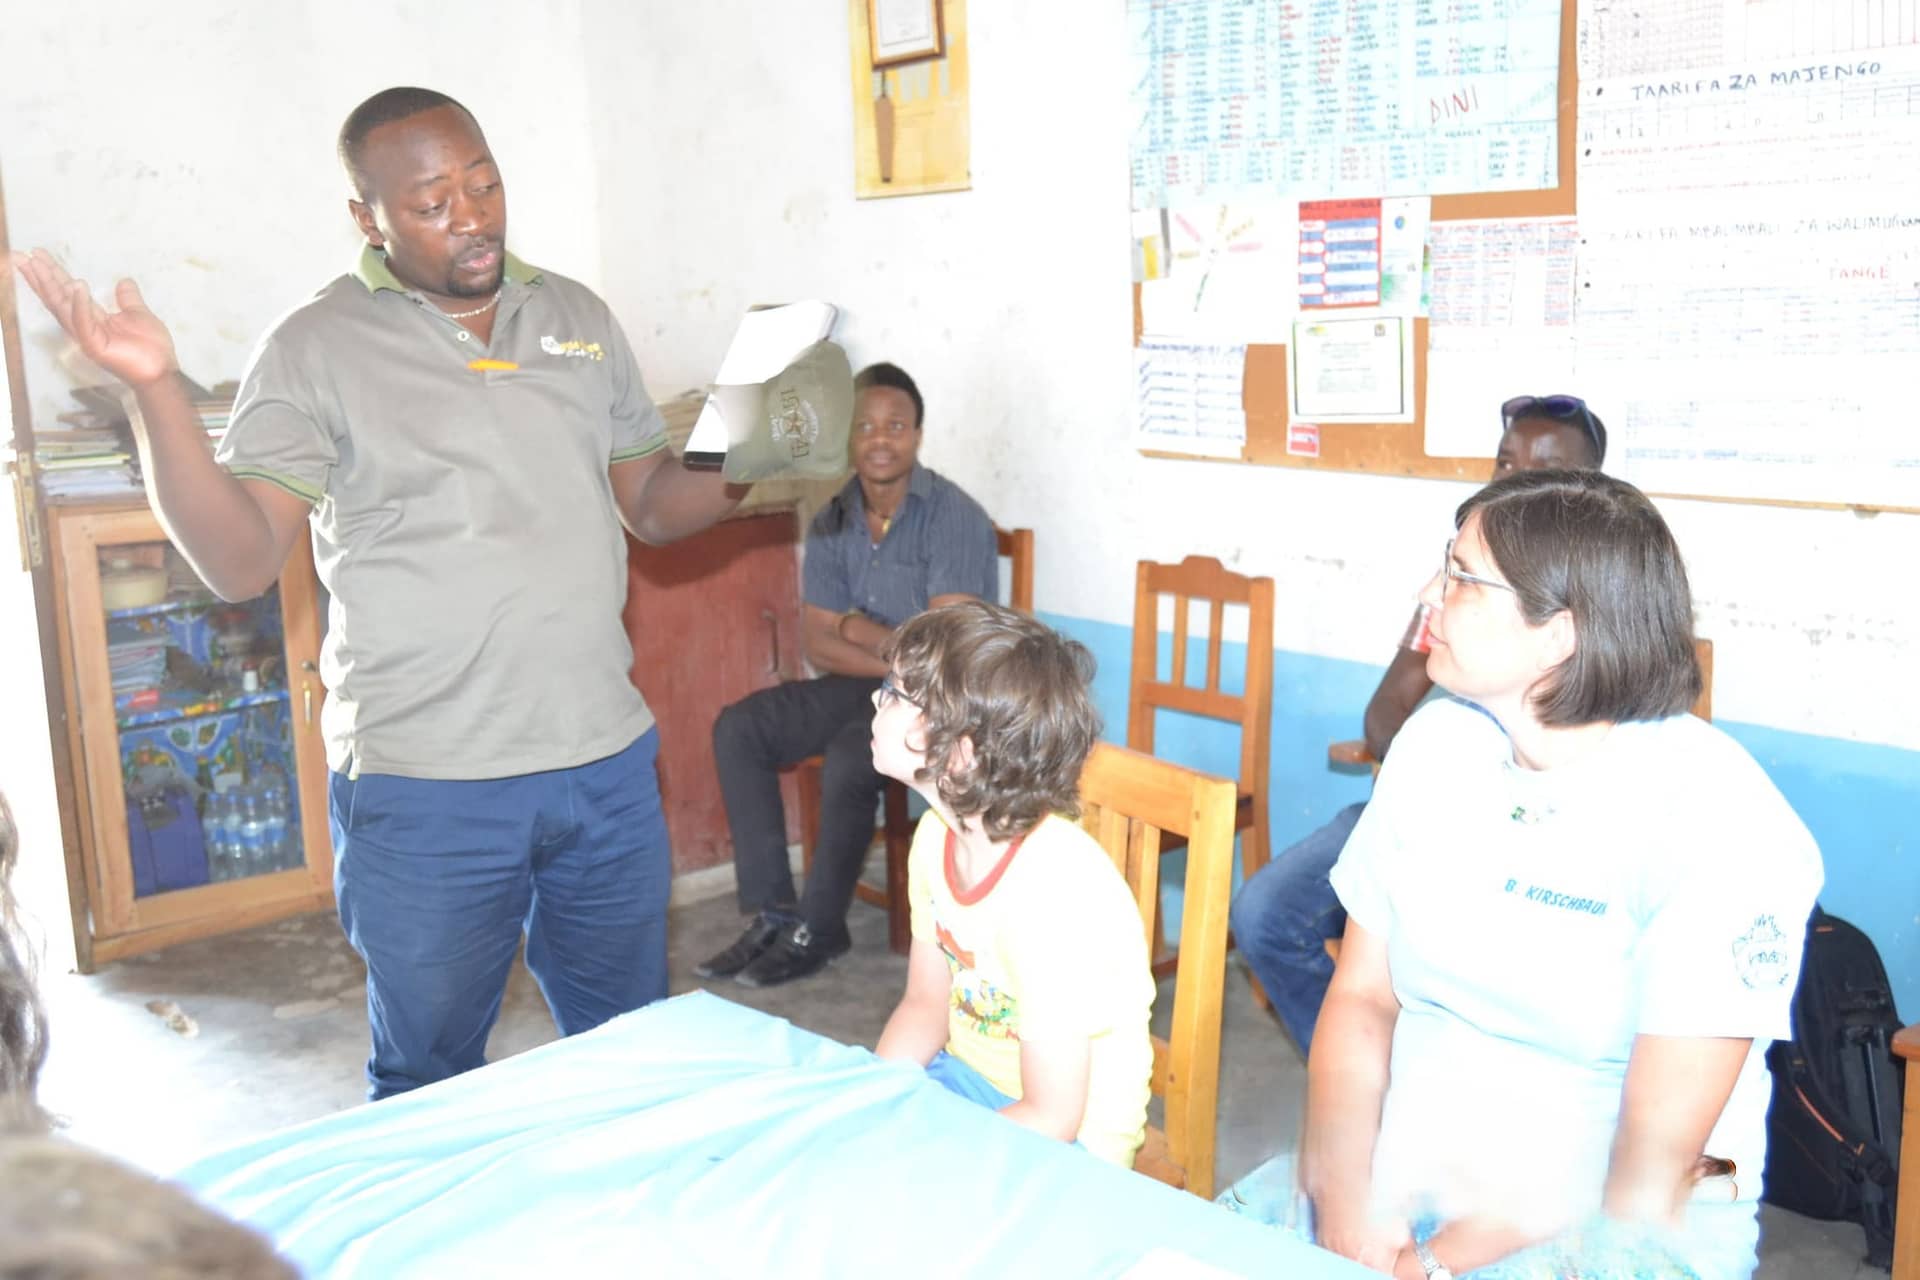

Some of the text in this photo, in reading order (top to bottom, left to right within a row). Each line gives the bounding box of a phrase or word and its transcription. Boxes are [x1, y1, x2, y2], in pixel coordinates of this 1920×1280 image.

[1632, 61, 1882, 101] TAARIFA ZA MAJENGO
[1430, 84, 1479, 125] DINI
